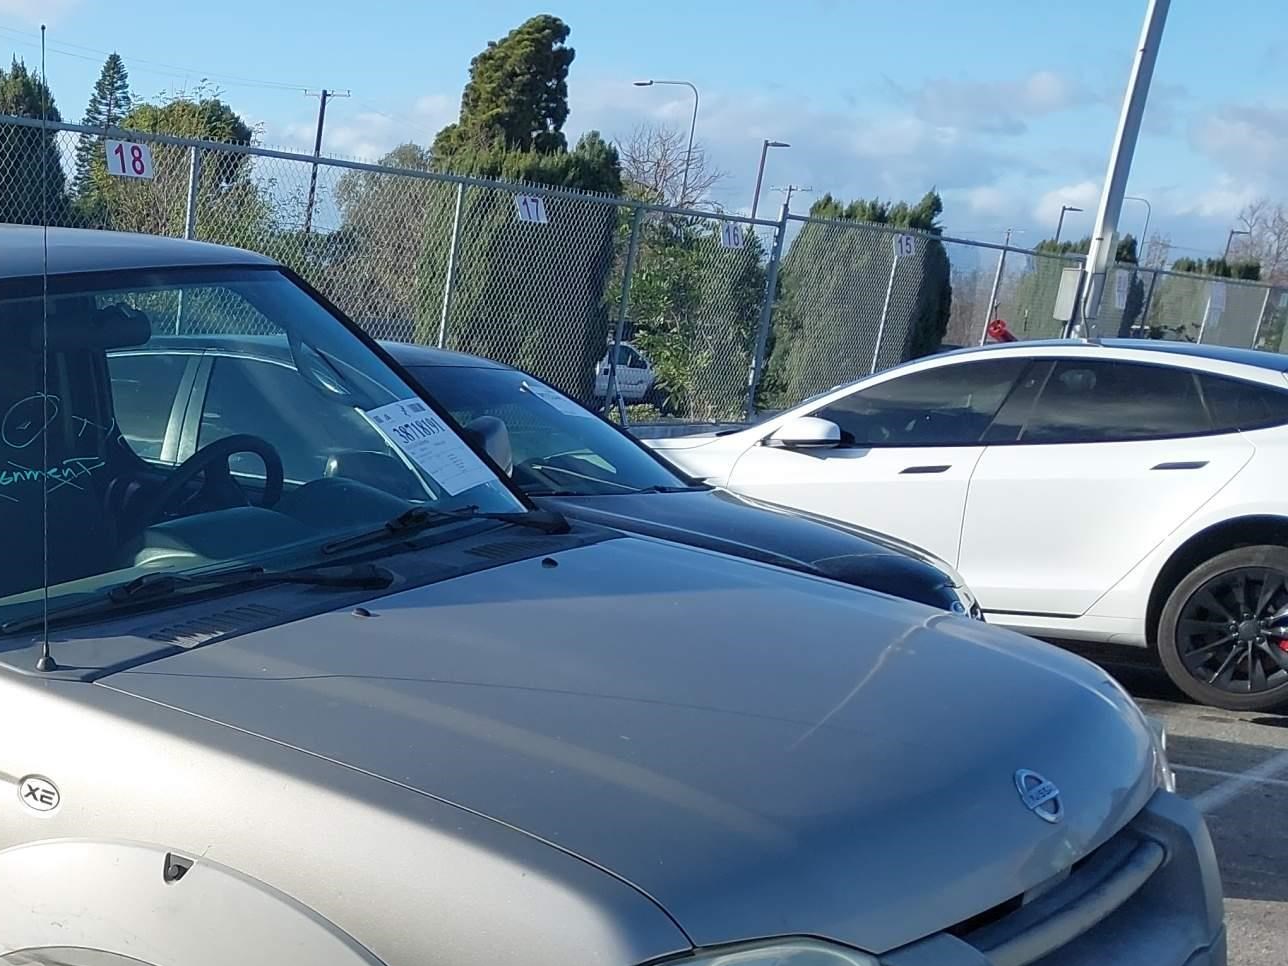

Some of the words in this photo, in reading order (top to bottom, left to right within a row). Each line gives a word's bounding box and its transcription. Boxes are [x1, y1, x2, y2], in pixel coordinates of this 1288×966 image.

[114, 143, 145, 175] 18
[522, 197, 540, 221] 17
[725, 225, 740, 247] 16
[897, 236, 912, 255] 15
[392, 417, 446, 444] 38718191
[24, 783, 55, 805] XE
